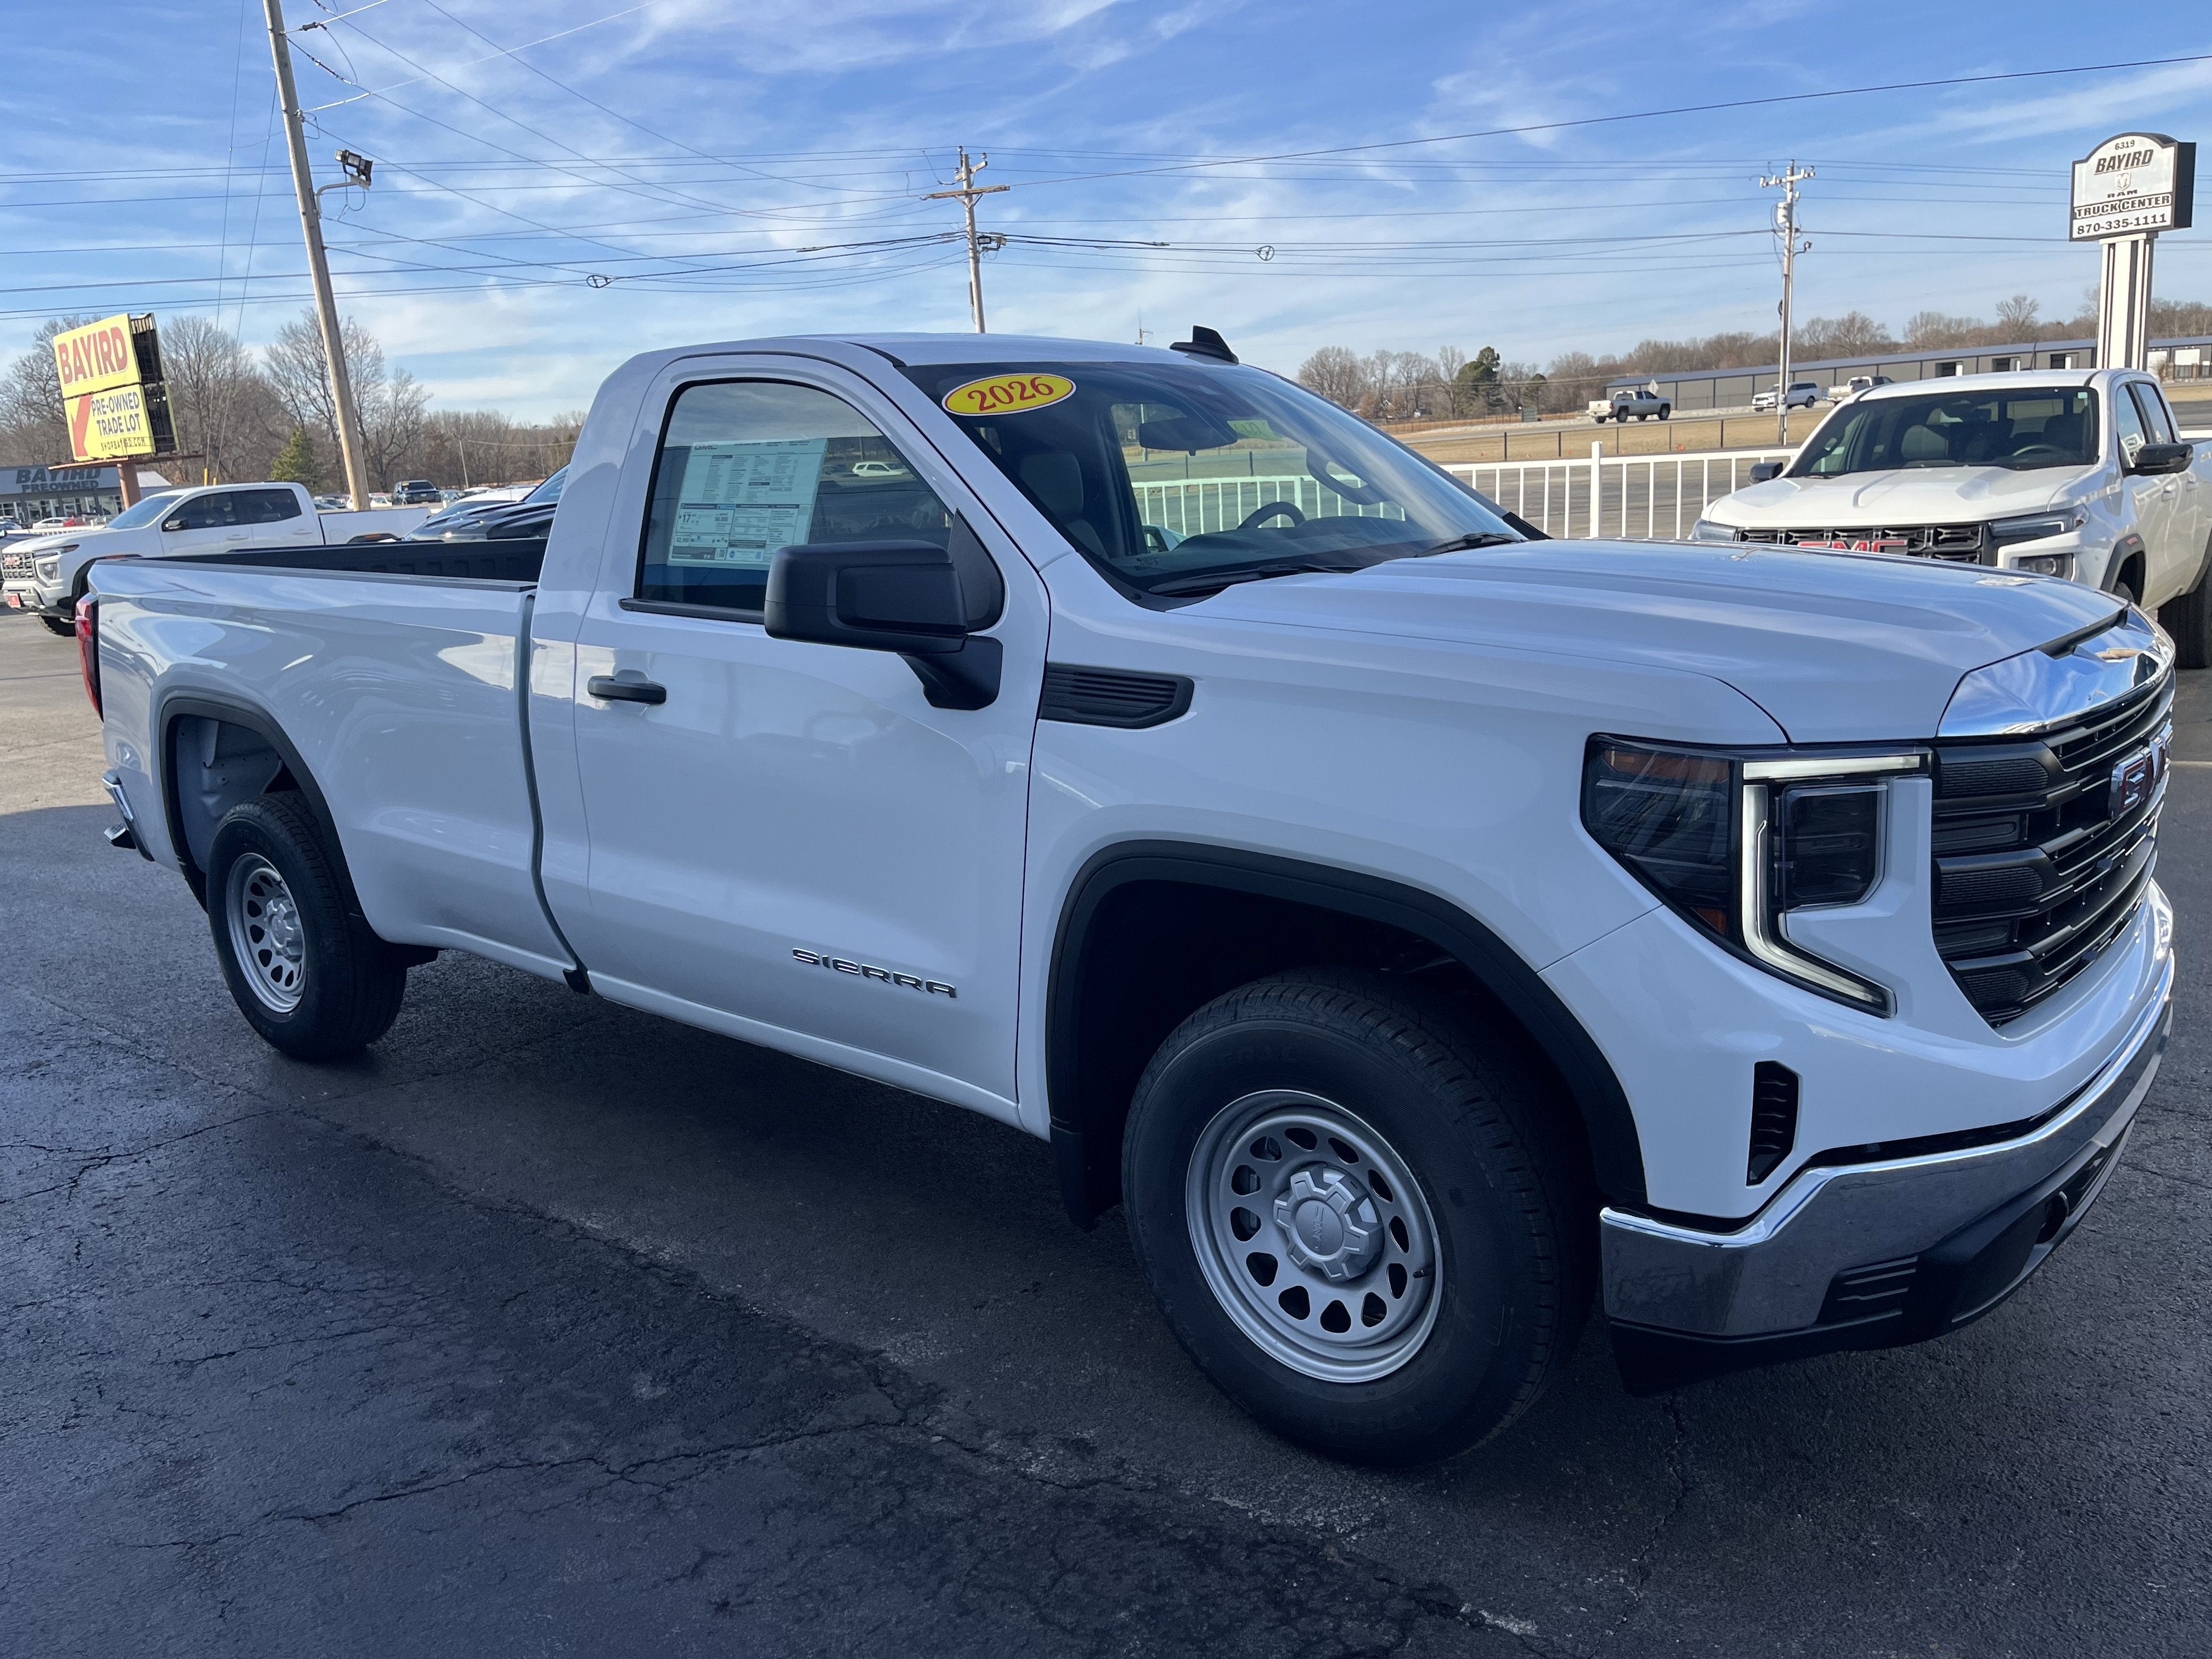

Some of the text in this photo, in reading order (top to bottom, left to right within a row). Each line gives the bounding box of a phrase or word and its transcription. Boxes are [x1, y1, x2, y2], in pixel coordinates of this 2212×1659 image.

[2115, 139, 2135, 150] 6319
[2095, 149, 2153, 174] BAYIRD
[2107, 189, 2137, 198] RAM
[2076, 195, 2170, 218] TRUCK CENTER
[2077, 213, 2167, 235] 870-335-1111
[58, 326, 128, 384] BAYIRD
[91, 392, 139, 416] PRE-OWNED
[967, 376, 1054, 411] 2026
[97, 413, 141, 436] TRADE LOT
[16, 468, 101, 483] BAYIRD
[21, 480, 99, 493] PREOWNED
[792, 947, 957, 998] SIERRA
